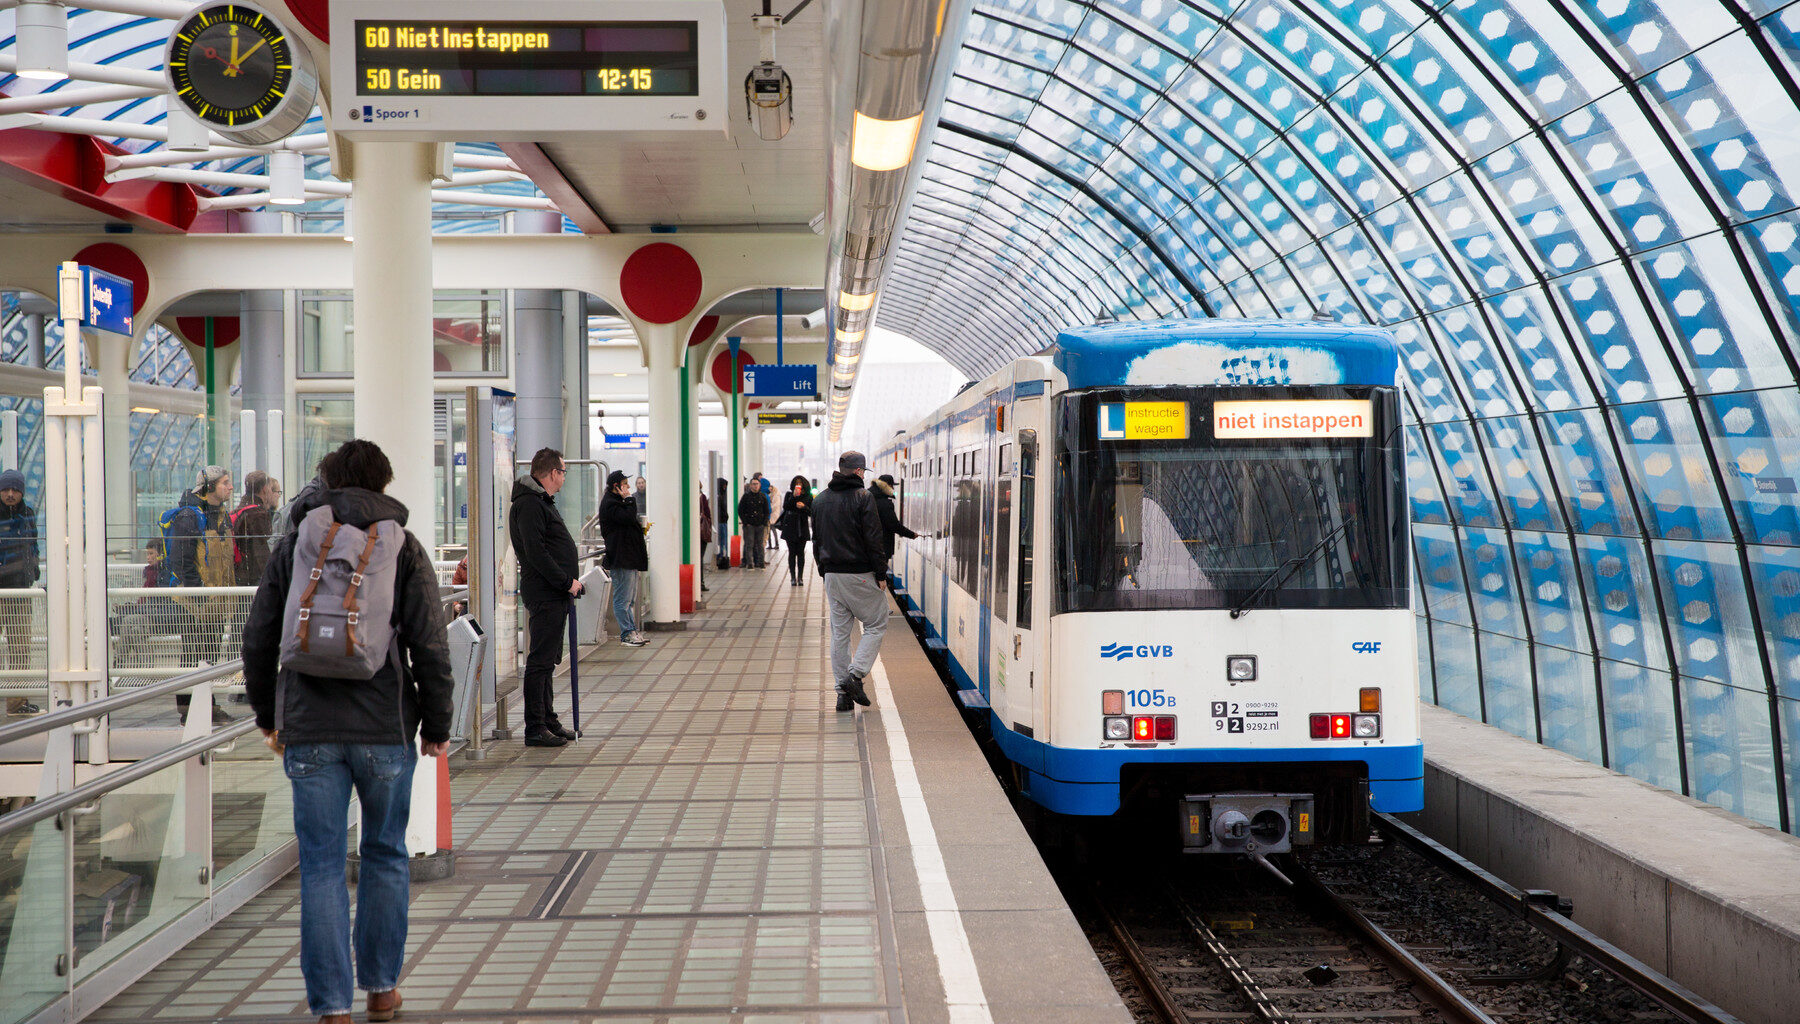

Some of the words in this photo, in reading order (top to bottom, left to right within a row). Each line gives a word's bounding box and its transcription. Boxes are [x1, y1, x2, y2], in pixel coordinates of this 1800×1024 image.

[365, 27, 390, 48] 60
[396, 27, 440, 48] Niet
[443, 27, 549, 52] Instappen
[366, 68, 391, 90] 50
[397, 68, 441, 90] Gein
[598, 68, 652, 90] 12:15
[376, 109, 410, 121] Spoor
[414, 109, 419, 118] 1
[793, 380, 812, 390] Lift
[1127, 408, 1180, 418] instructie
[1100, 405, 1124, 438] L
[1218, 413, 1255, 430] niet
[1263, 413, 1363, 433] instappen
[1134, 424, 1173, 435] wagen
[457, 456, 465, 465] 4
[1136, 645, 1173, 658] GVB
[1352, 641, 1382, 653] CAF
[1246, 721, 1279, 731] 9292.nl
